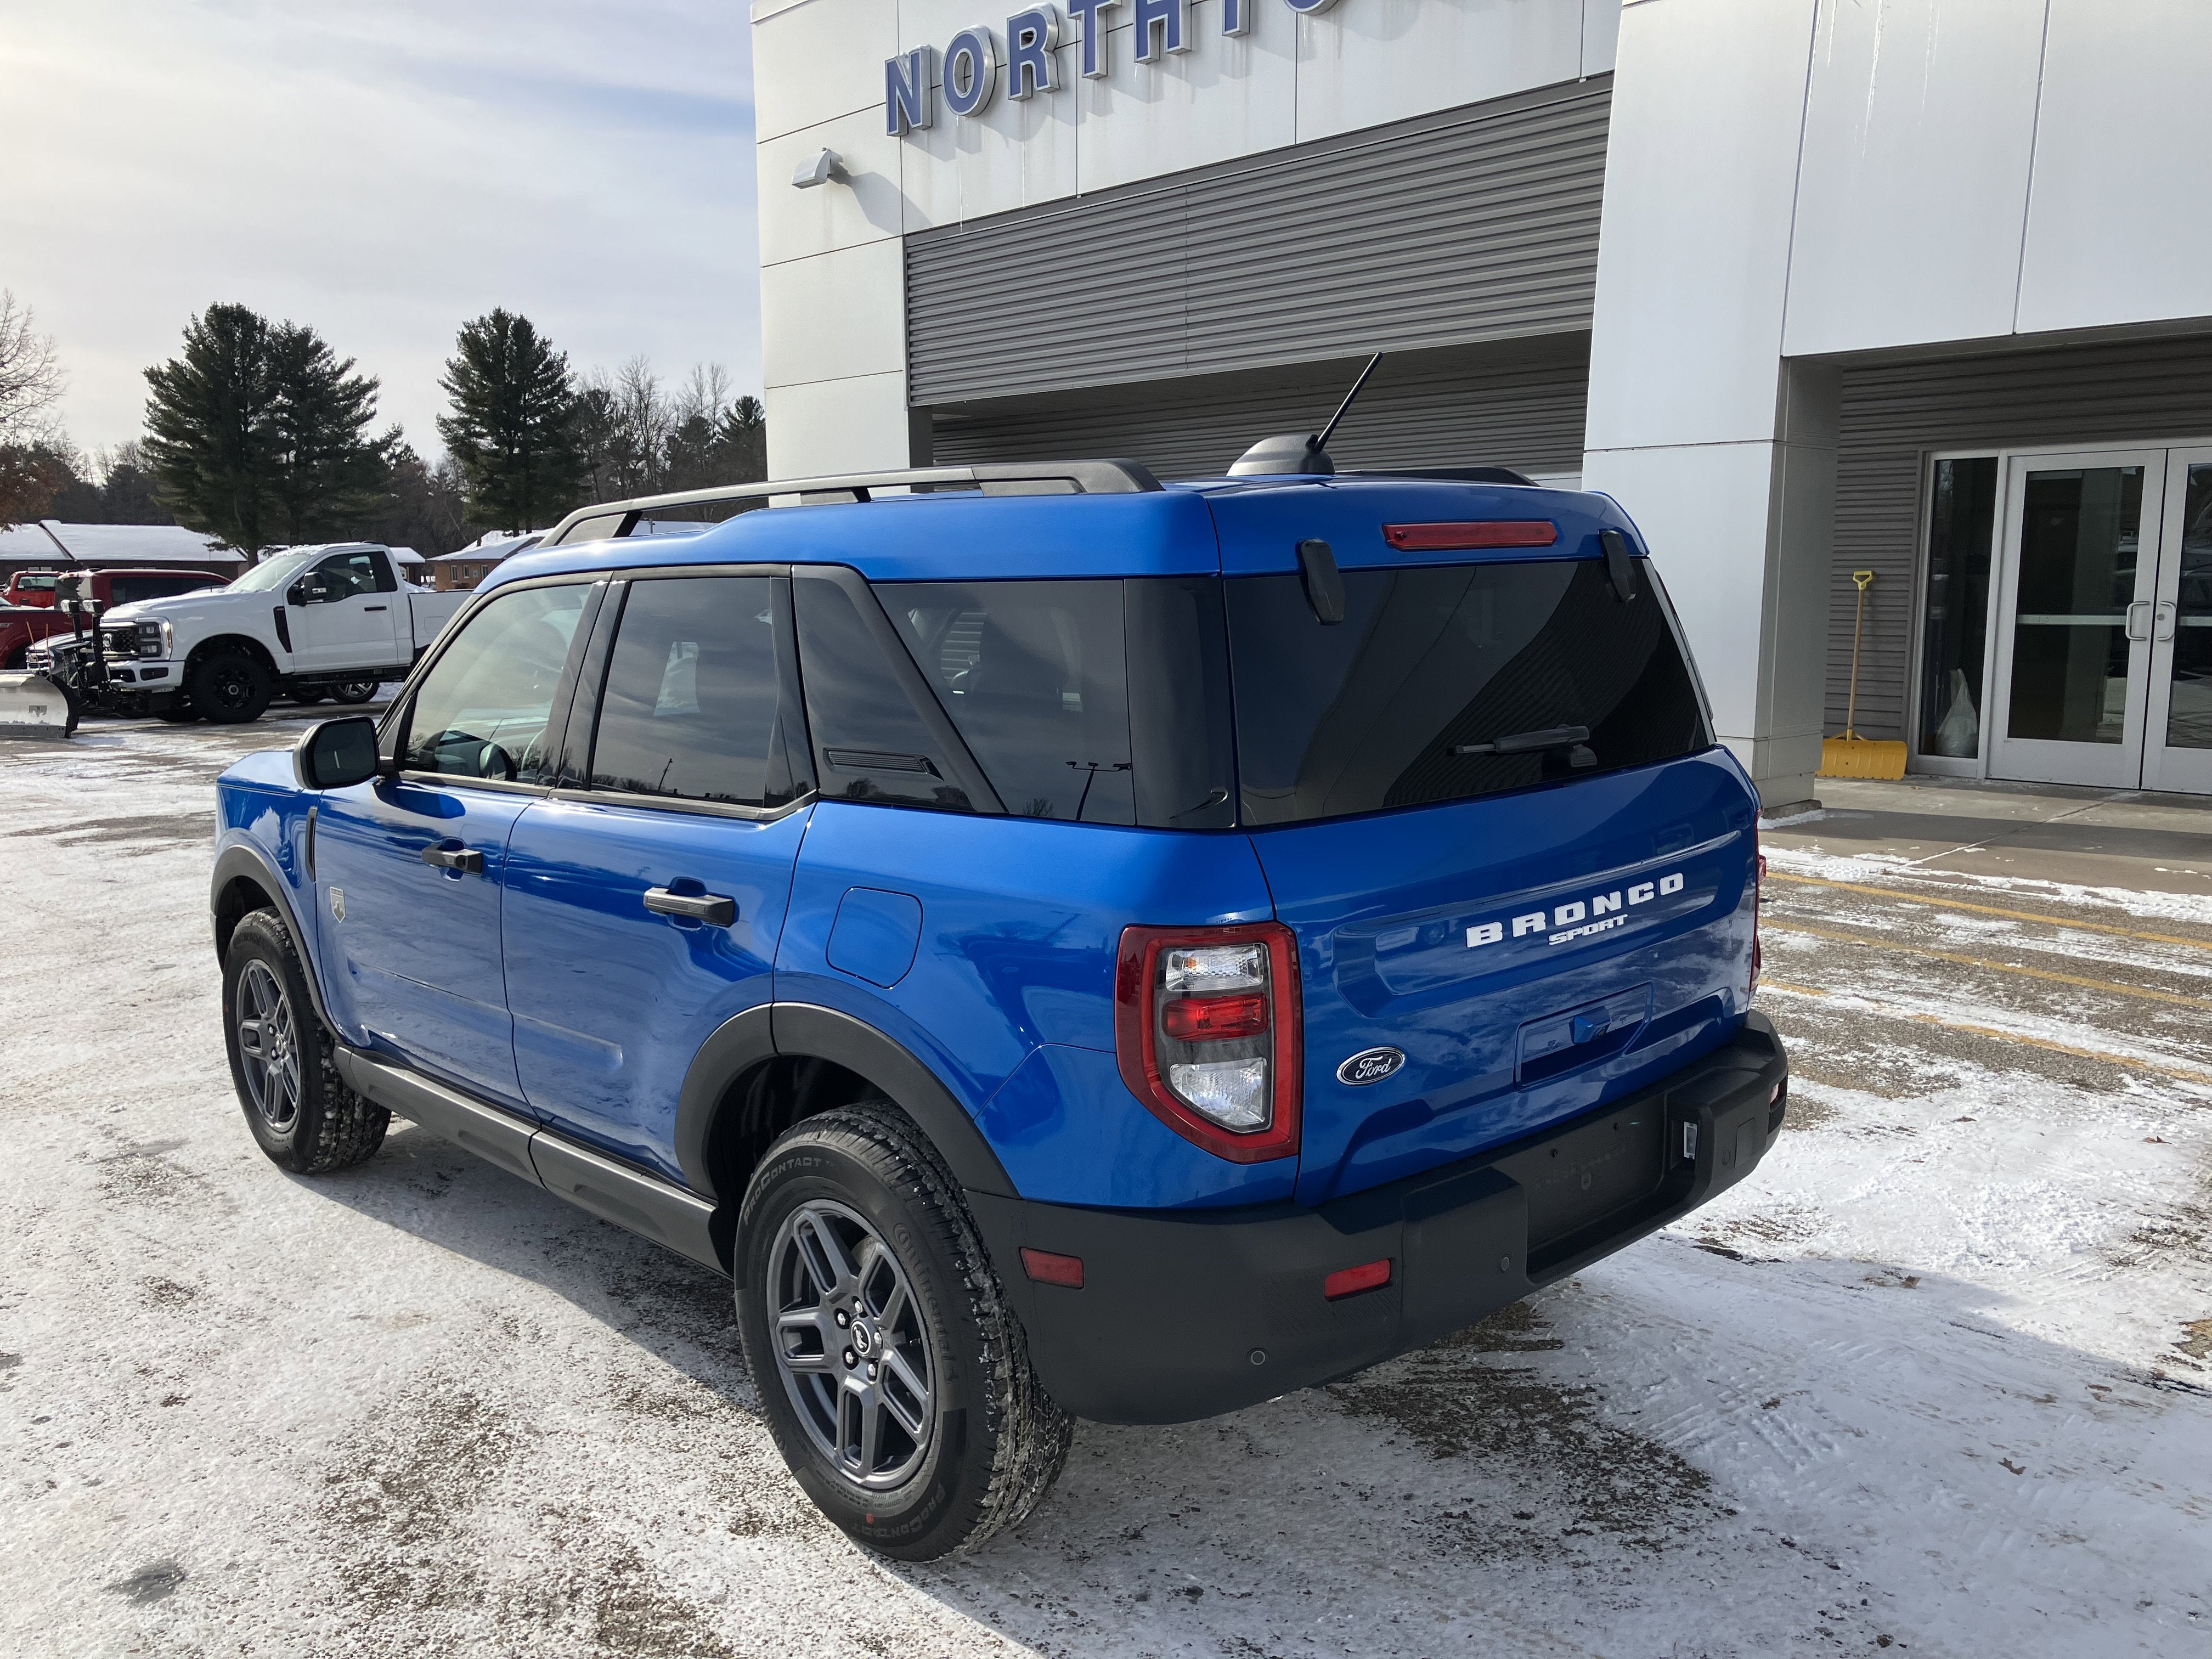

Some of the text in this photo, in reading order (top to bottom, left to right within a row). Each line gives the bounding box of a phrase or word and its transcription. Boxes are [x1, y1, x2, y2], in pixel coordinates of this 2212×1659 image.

[885, 0, 1338, 137] NORTH
[1465, 872, 1684, 948] BRONCO
[1549, 914, 1628, 946] SPORT
[1355, 1056, 1392, 1079] Ford
